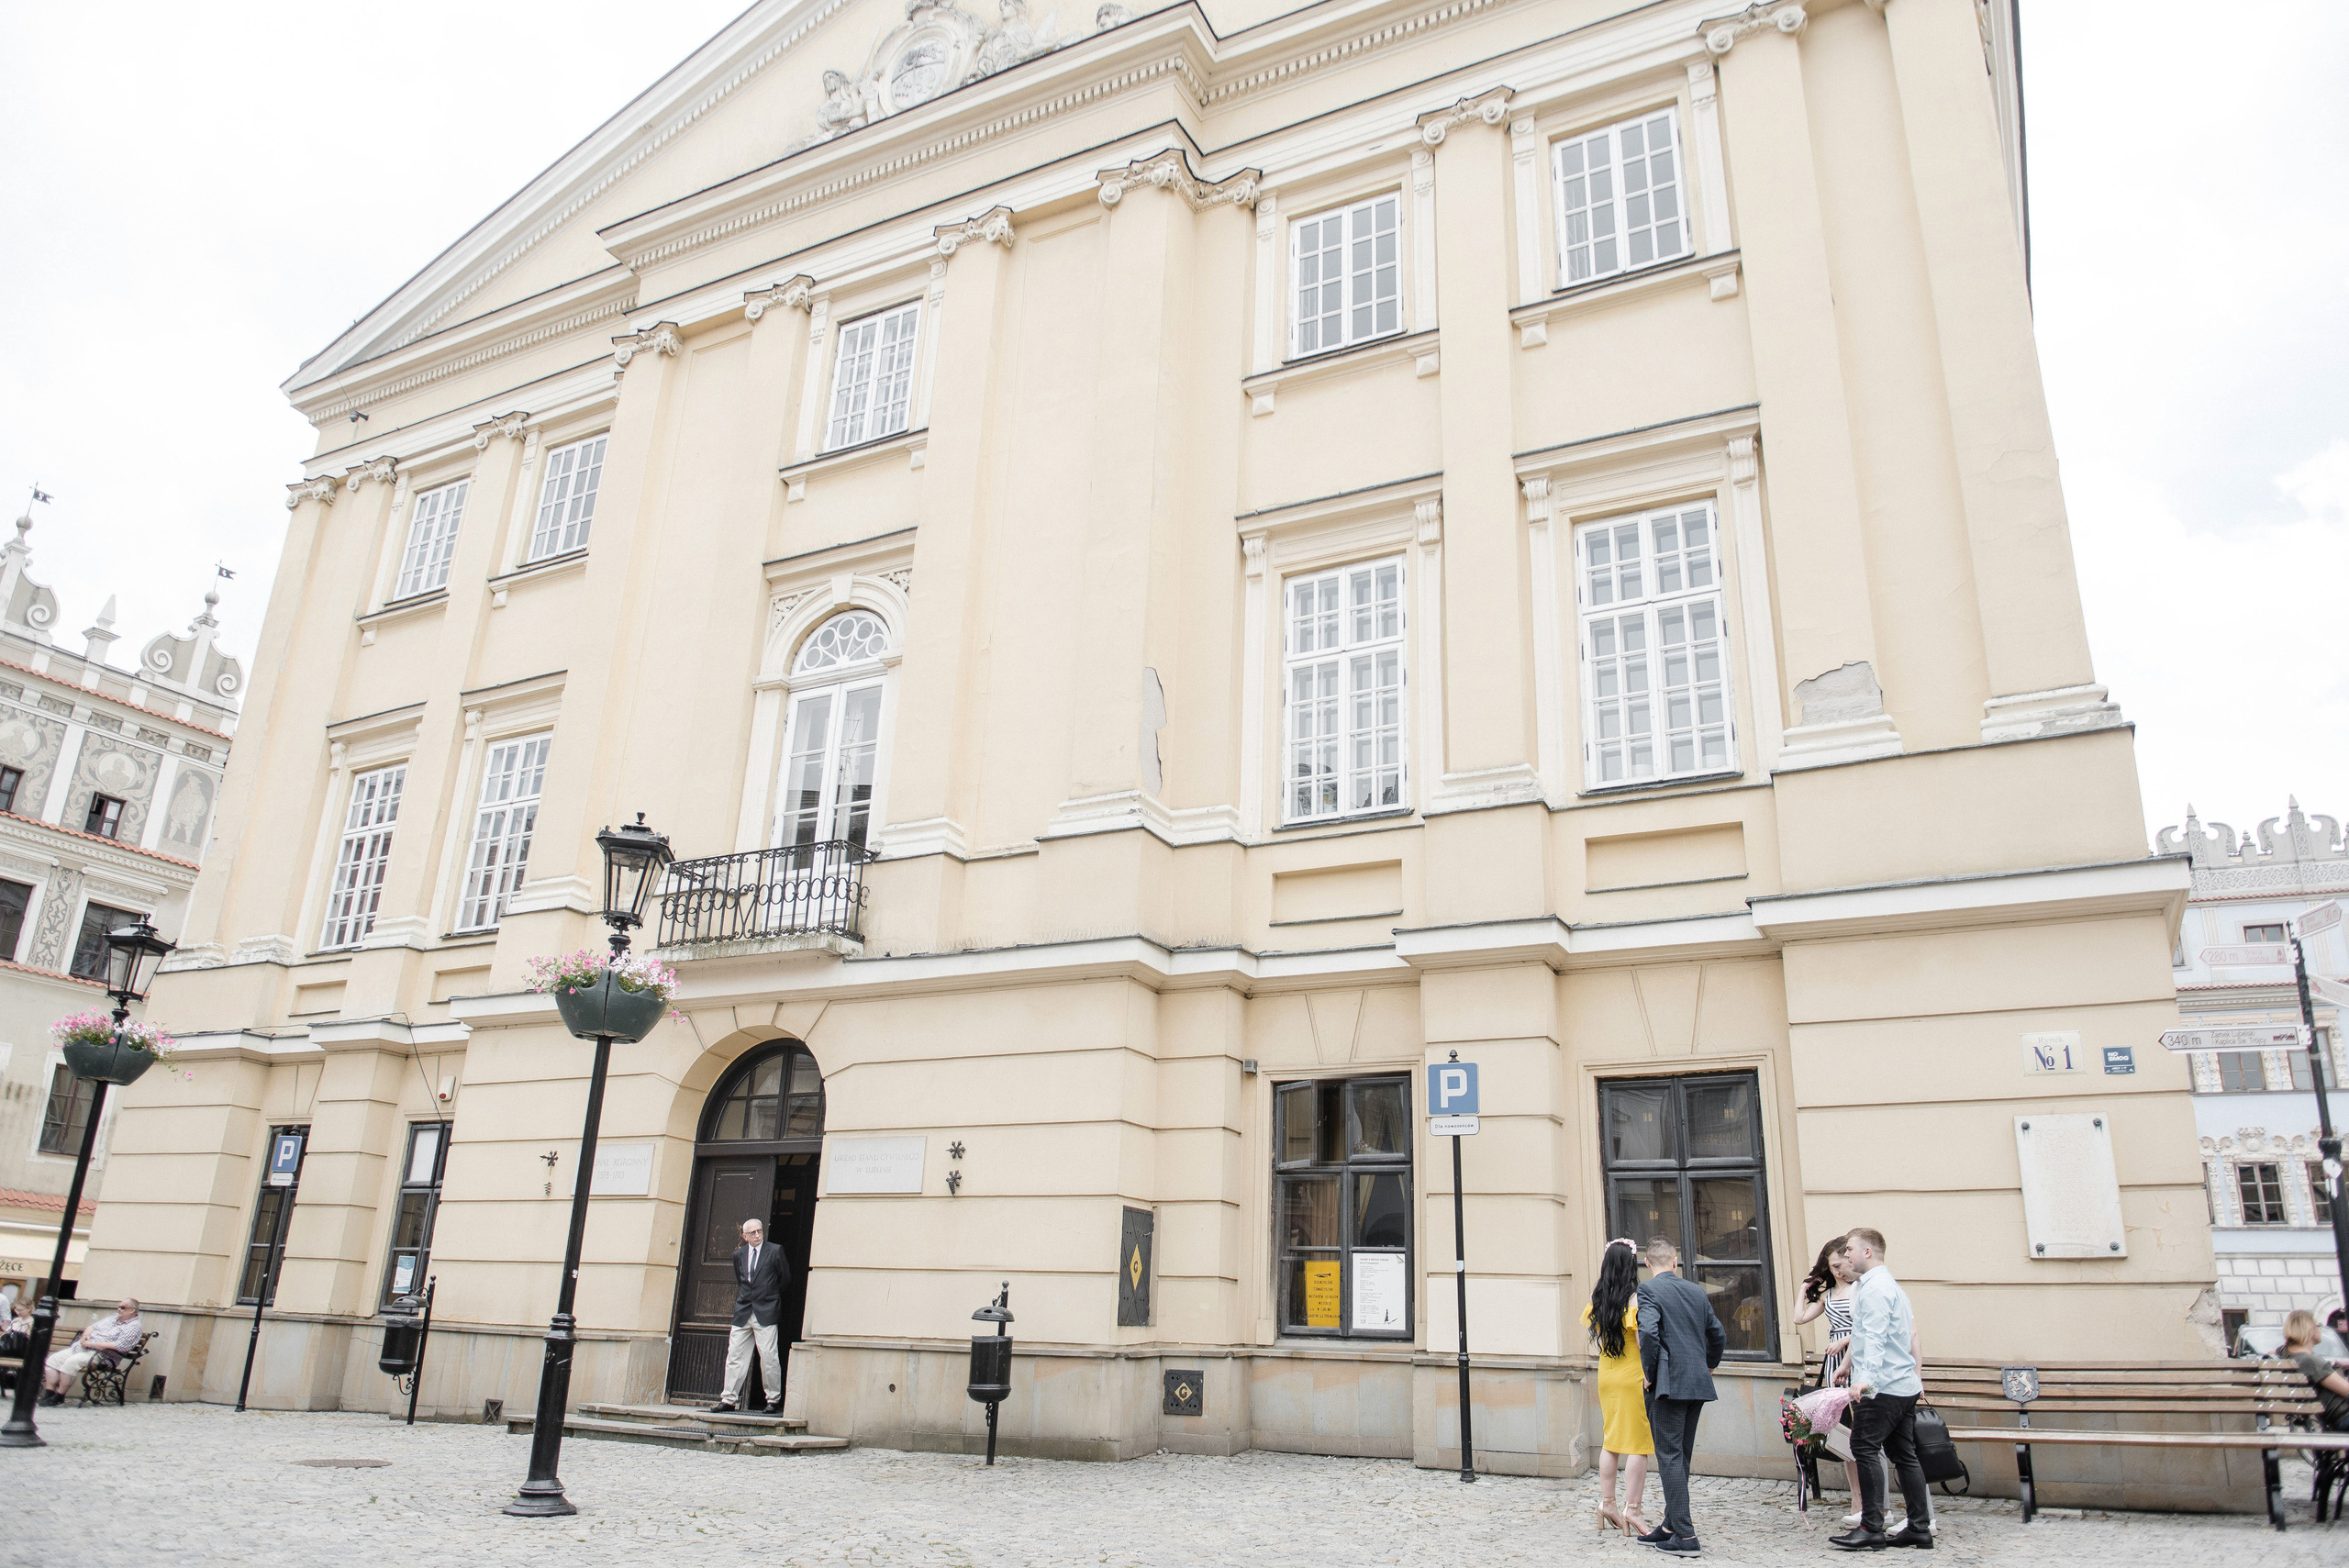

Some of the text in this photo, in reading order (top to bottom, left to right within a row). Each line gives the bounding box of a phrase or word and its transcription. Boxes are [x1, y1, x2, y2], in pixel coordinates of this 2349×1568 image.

[2209, 951, 2238, 962] 280 m
[2167, 1035, 2201, 1046] 340 m
[2063, 1044, 2074, 1070] 1
[1440, 1069, 1467, 1108] P
[277, 1140, 295, 1167] P
[880, 1152, 919, 1161] CYWILNEGO
[613, 1157, 649, 1166] KORONNY
[865, 1165, 893, 1173] LUBLINIE
[1133, 1260, 1139, 1273] G
[1178, 1385, 1187, 1398] G
